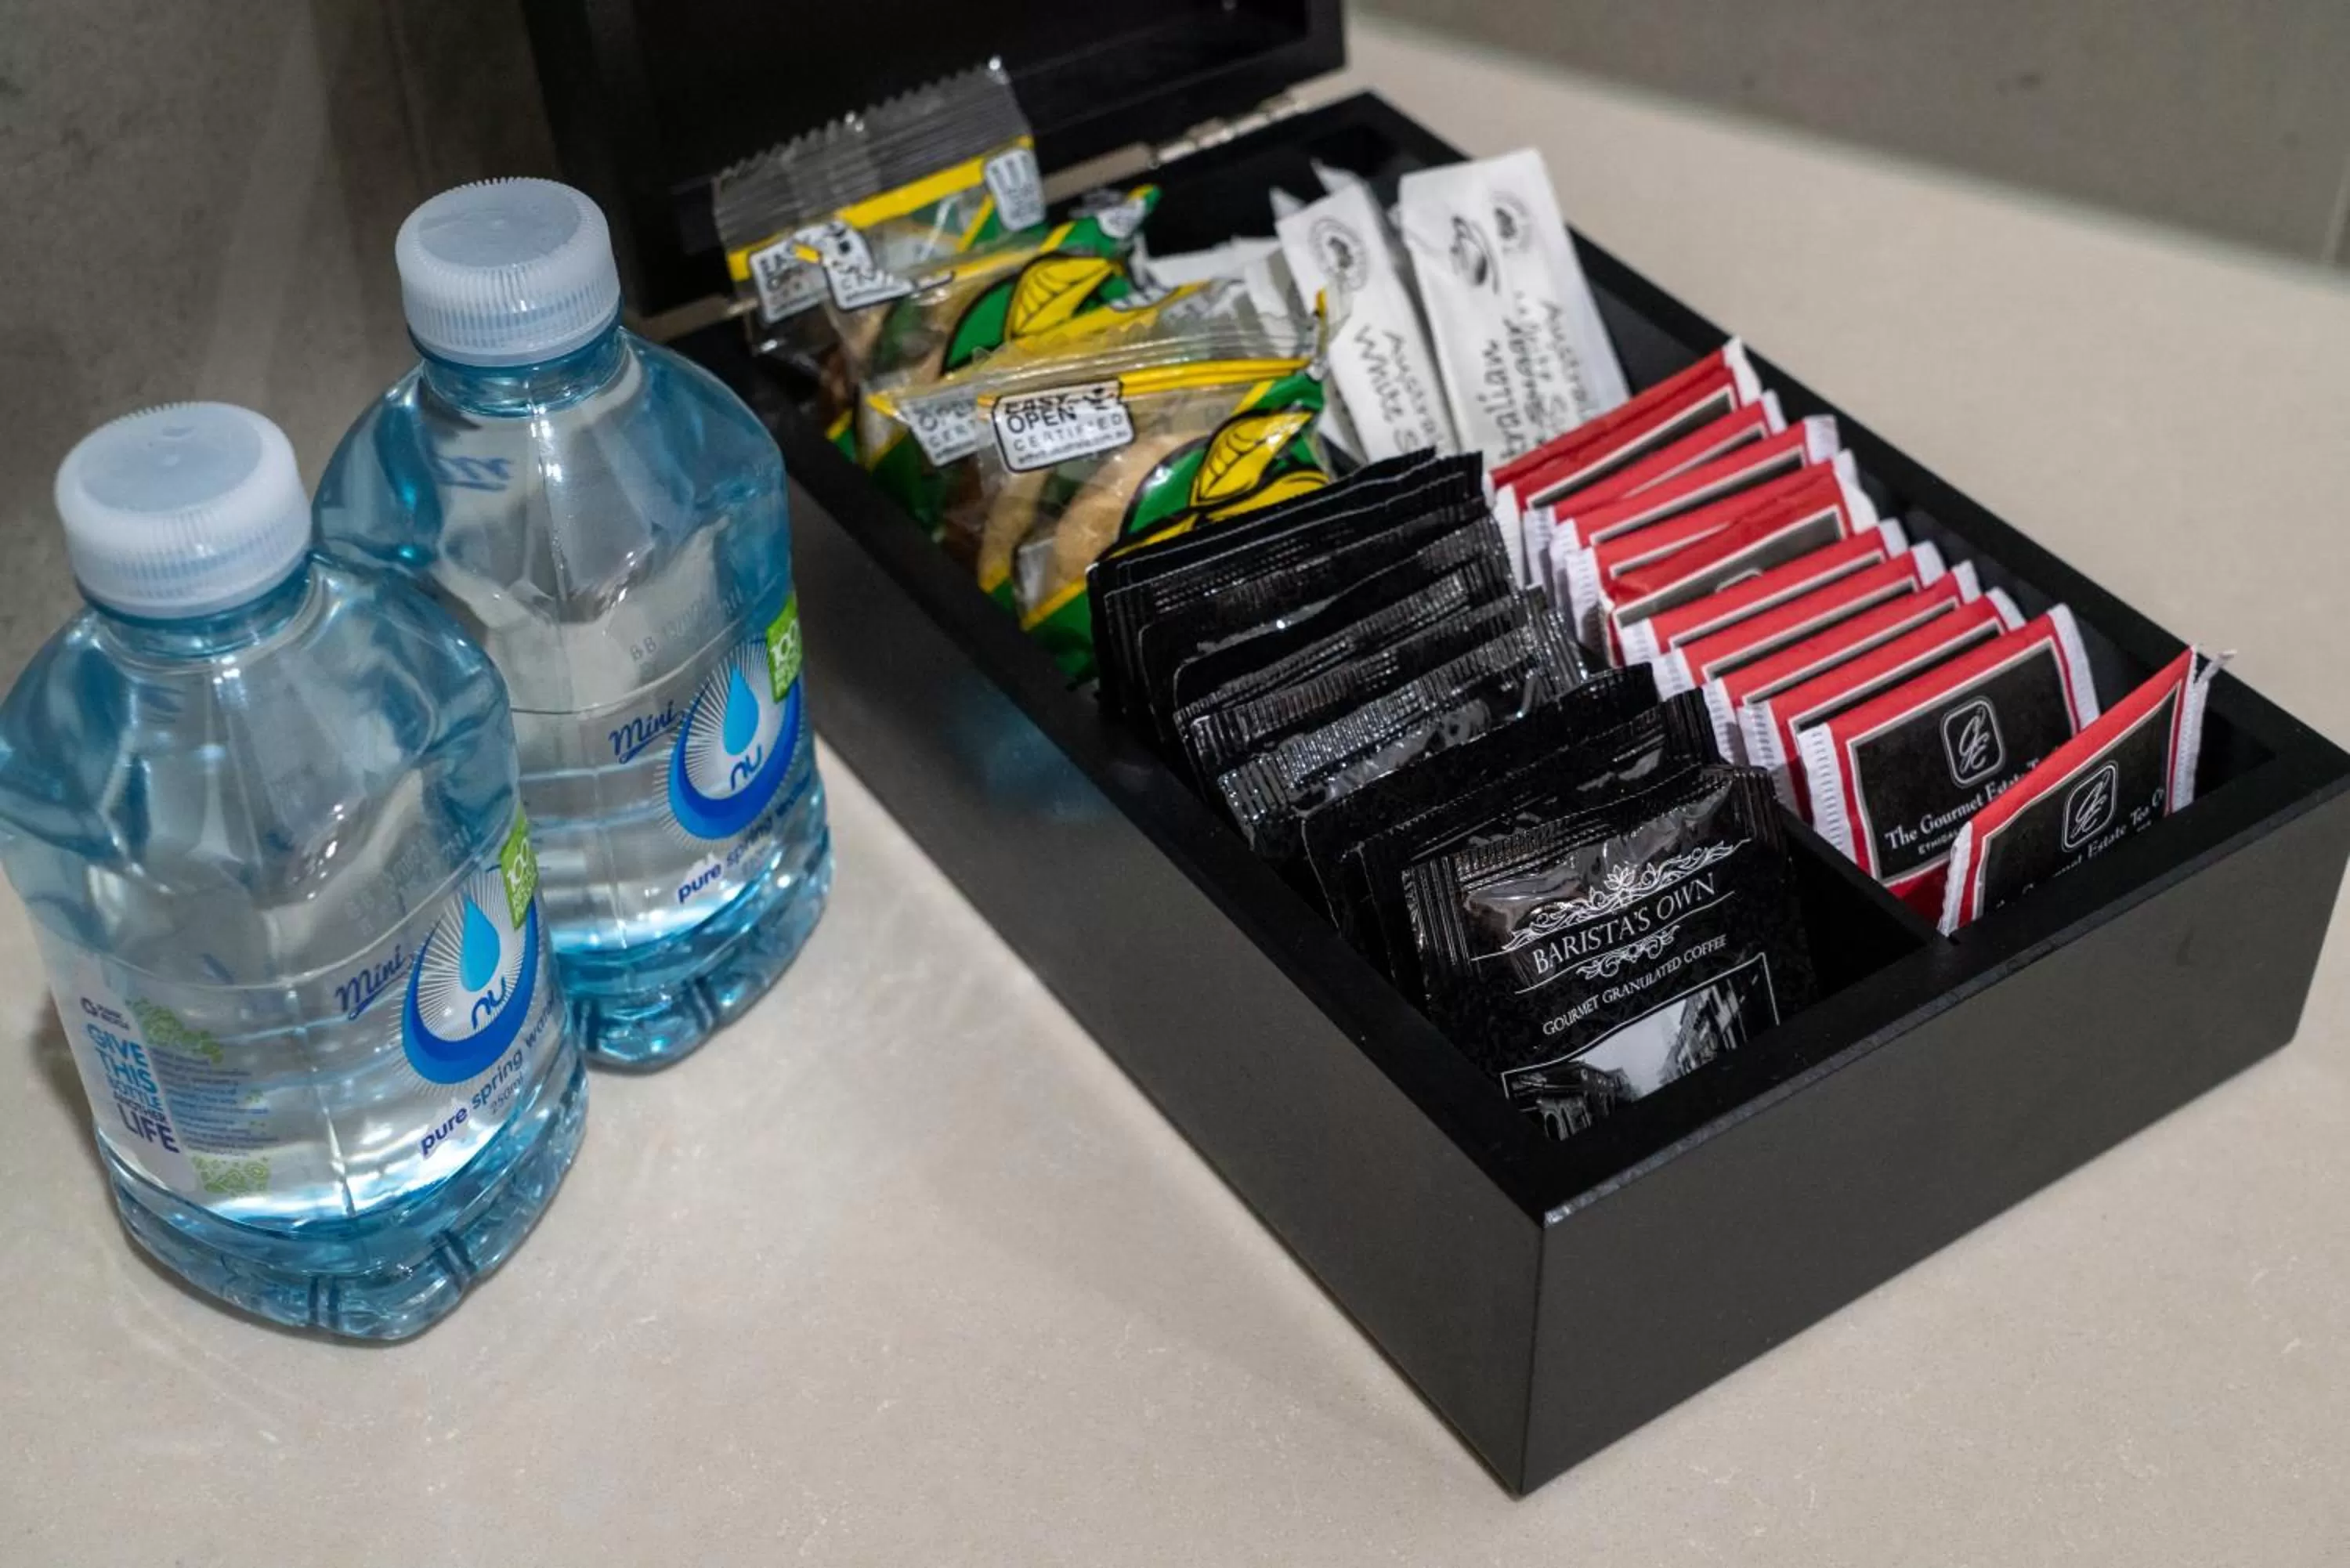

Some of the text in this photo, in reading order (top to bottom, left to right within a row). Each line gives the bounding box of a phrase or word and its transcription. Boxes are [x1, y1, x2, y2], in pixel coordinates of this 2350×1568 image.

[1354, 323, 1403, 424] White
[1007, 406, 1077, 434] OPEN
[608, 700, 680, 764] Mini
[730, 744, 762, 790] nu
[1884, 824, 1918, 851] The
[1920, 793, 1984, 834] Gourmet
[2088, 825, 2128, 858] Estate
[2130, 806, 2149, 825] Tea
[678, 863, 721, 904] pure
[1532, 872, 1716, 974] BARISTA'S OWN
[334, 945, 409, 1019] Mini
[472, 977, 508, 1030] nu
[1542, 934, 1727, 1035] GOURMET GRANULATED COFFEE
[86, 1023, 149, 1068] GIVE
[95, 1046, 158, 1094] THIS
[118, 1102, 180, 1154] LIFE
[421, 1106, 468, 1156] pure
[472, 1049, 522, 1109] spring
